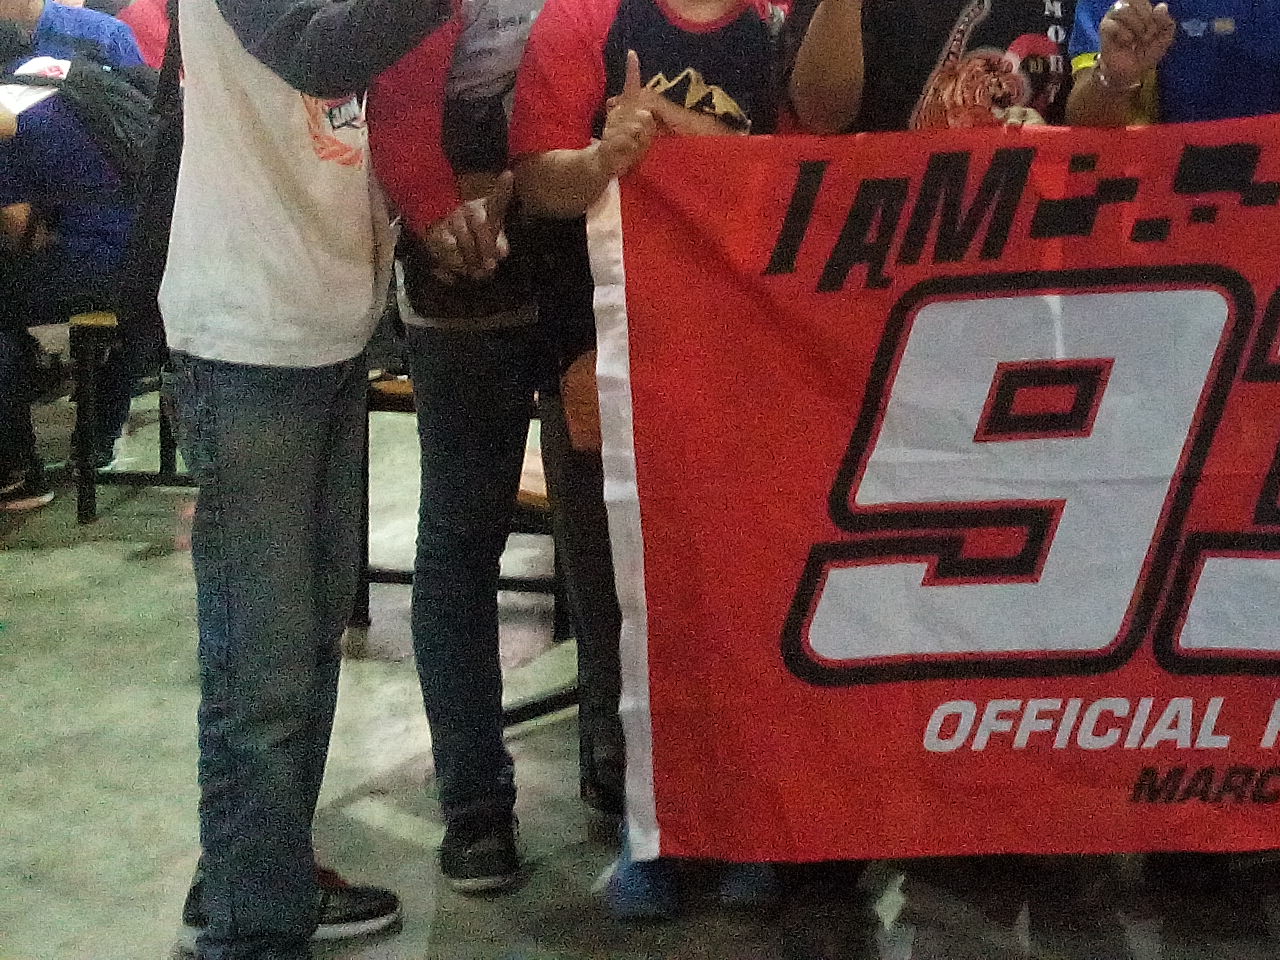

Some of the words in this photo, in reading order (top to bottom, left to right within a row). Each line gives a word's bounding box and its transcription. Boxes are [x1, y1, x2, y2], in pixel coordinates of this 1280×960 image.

[761, 159, 830, 275] I
[816, 146, 1037, 293] AM
[923, 697, 1230, 752] OFFICIAL
